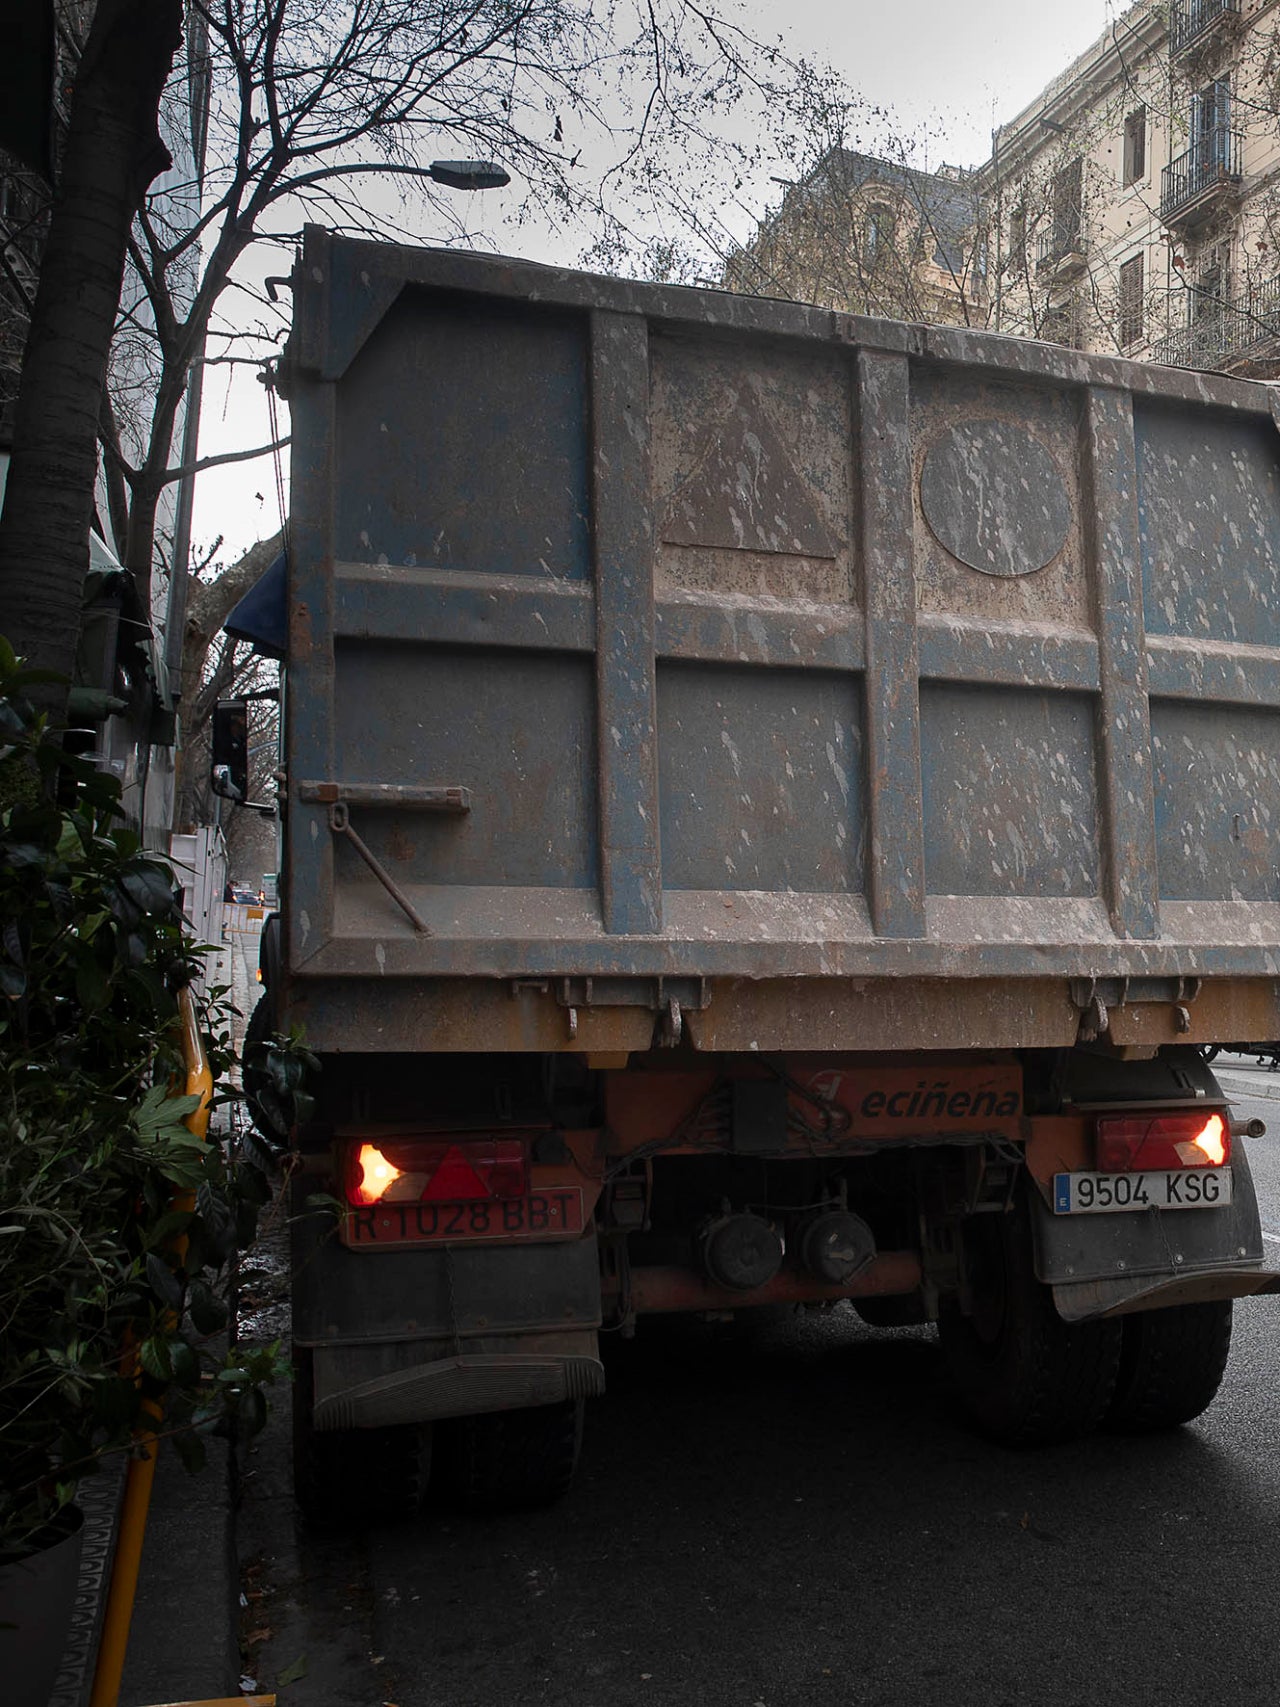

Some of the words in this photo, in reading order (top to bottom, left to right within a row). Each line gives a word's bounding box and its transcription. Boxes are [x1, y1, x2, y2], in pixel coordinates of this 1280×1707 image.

[1077, 1175, 1149, 1208] 9504
[1166, 1173, 1220, 1204] KSG
[354, 1207, 377, 1240] R
[393, 1201, 490, 1237] 1028
[503, 1193, 574, 1232] BBT
